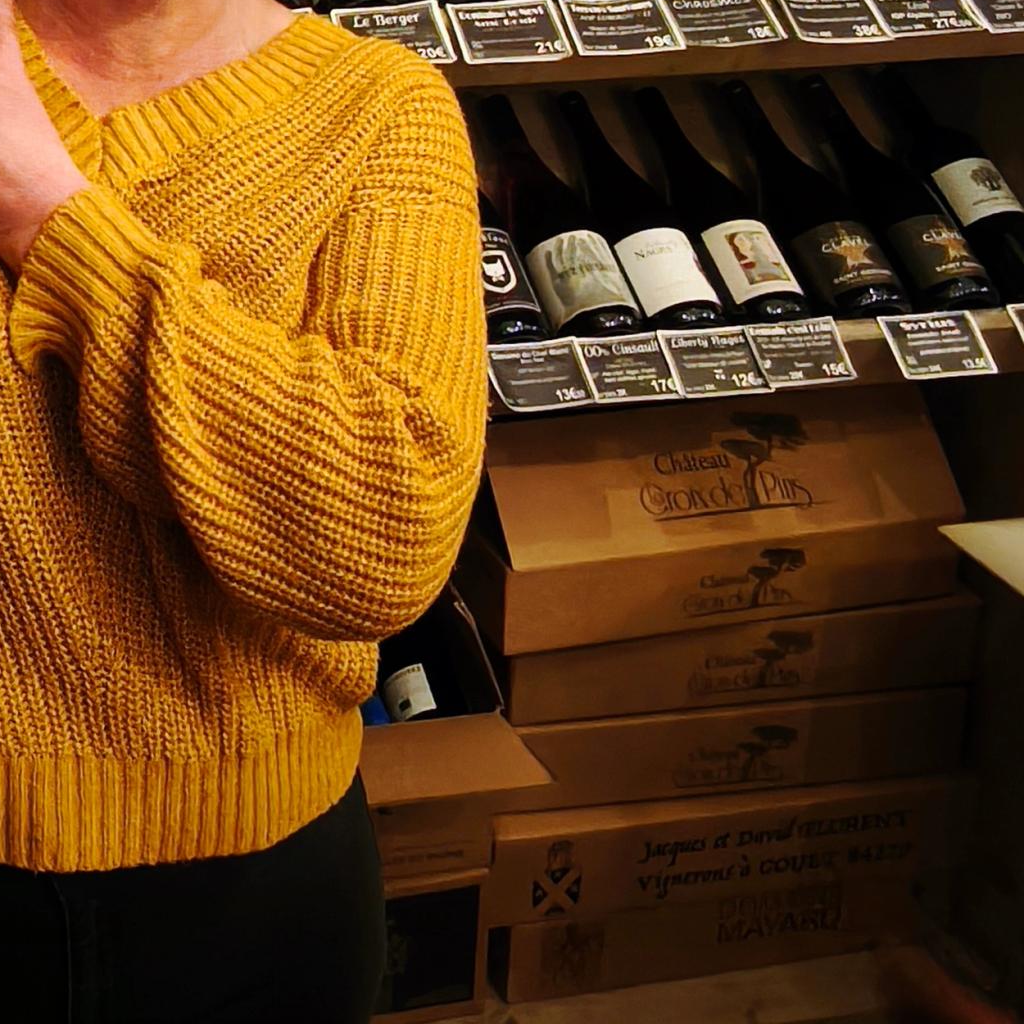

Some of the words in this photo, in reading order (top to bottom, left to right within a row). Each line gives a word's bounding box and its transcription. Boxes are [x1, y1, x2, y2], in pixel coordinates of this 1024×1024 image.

[353, 15, 371, 28] Le
[374, 12, 420, 27] Berger
[534, 39, 566, 54] 21€
[644, 33, 673, 49] 19€
[416, 45, 447, 59] 20€
[611, 338, 660, 356] Cinsault
[670, 335, 709, 350] Liberty
[711, 333, 746, 347] Nages
[650, 377, 677, 392] 17€
[638, 836, 707, 867] Jacques
